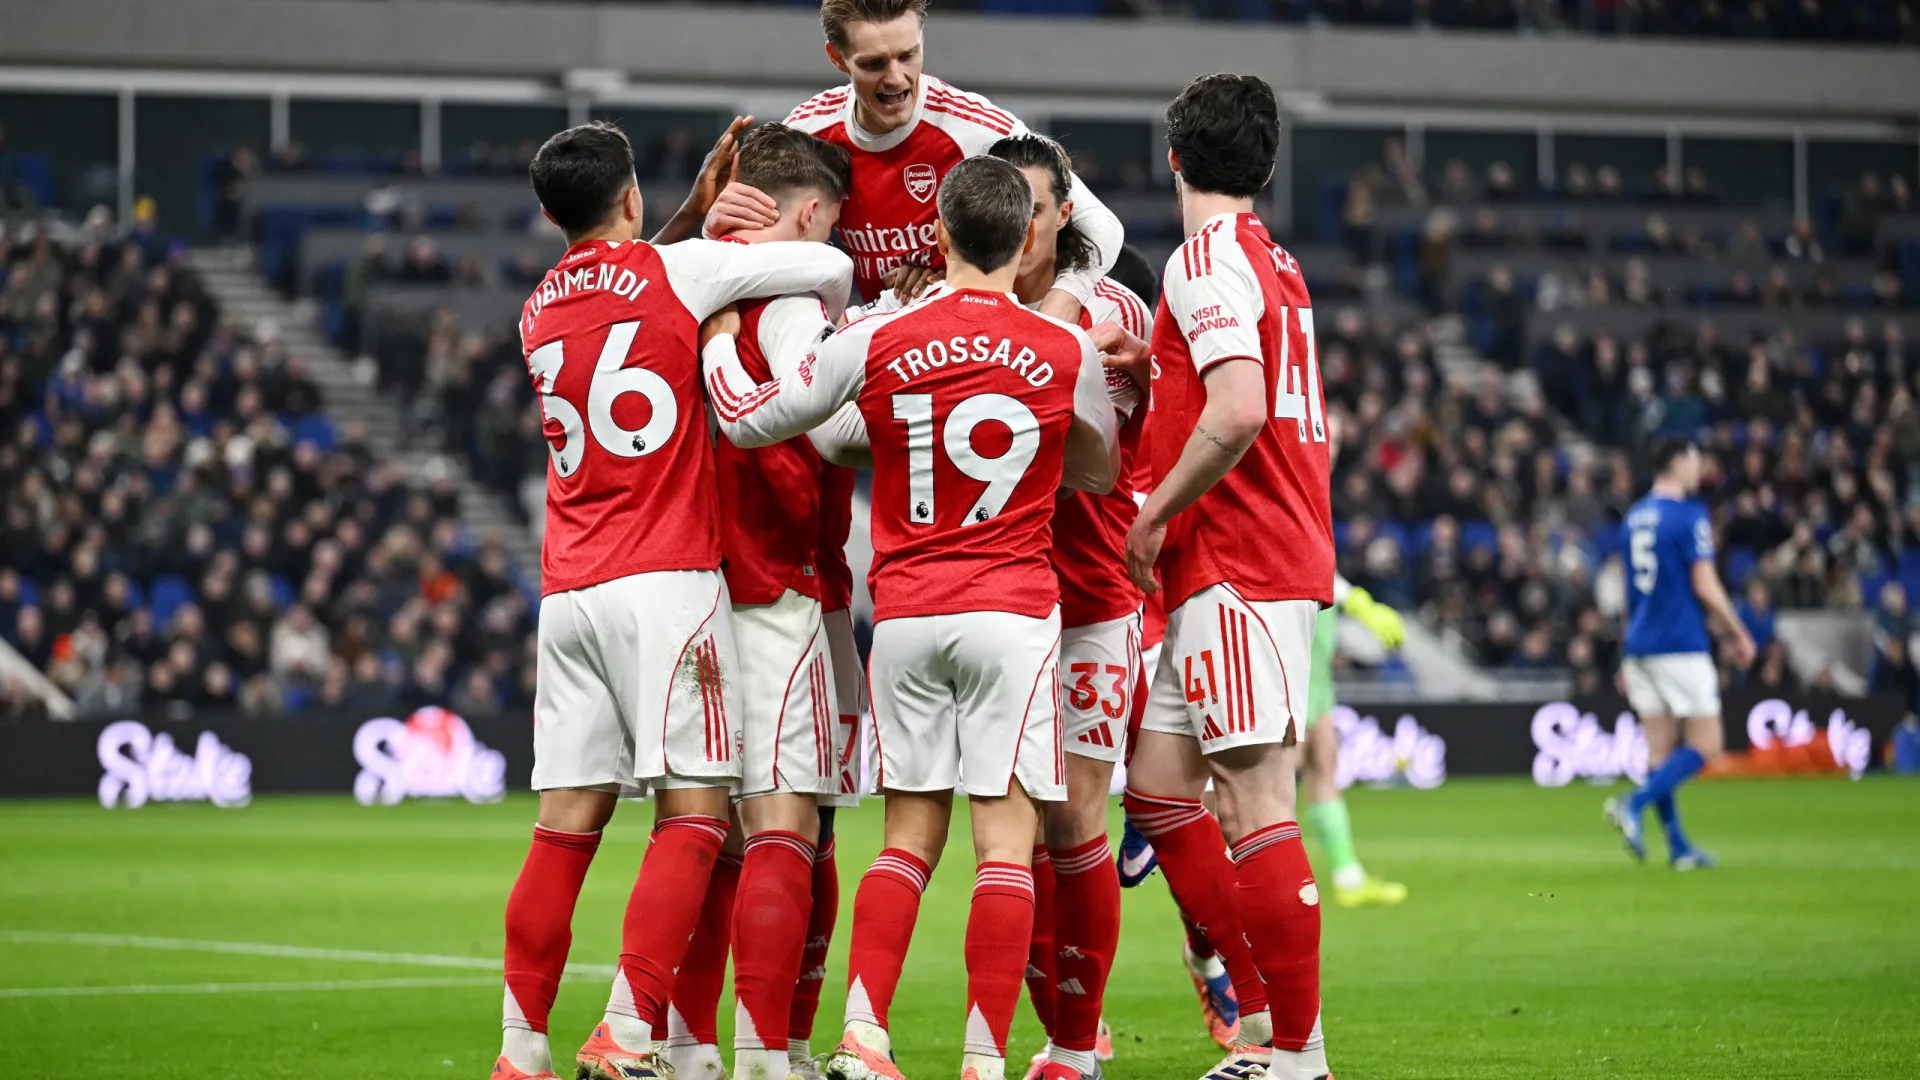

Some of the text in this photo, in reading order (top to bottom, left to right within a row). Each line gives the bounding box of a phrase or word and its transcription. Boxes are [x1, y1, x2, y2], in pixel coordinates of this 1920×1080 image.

[838, 222, 938, 253] mirate
[526, 263, 649, 335] ZUBIMENDI
[960, 294, 998, 307] Arsenal
[1191, 305, 1221, 323] VISIT
[1187, 317, 1239, 344] RWANDA
[886, 335, 1055, 388] TROSSARD
[1275, 305, 1327, 443] 41
[528, 320, 678, 479] 36
[891, 392, 1041, 528] 19
[1630, 529, 1658, 595] 5
[1069, 662, 1127, 720] 33
[1185, 649, 1218, 709] 41
[97, 720, 253, 809] Stake
